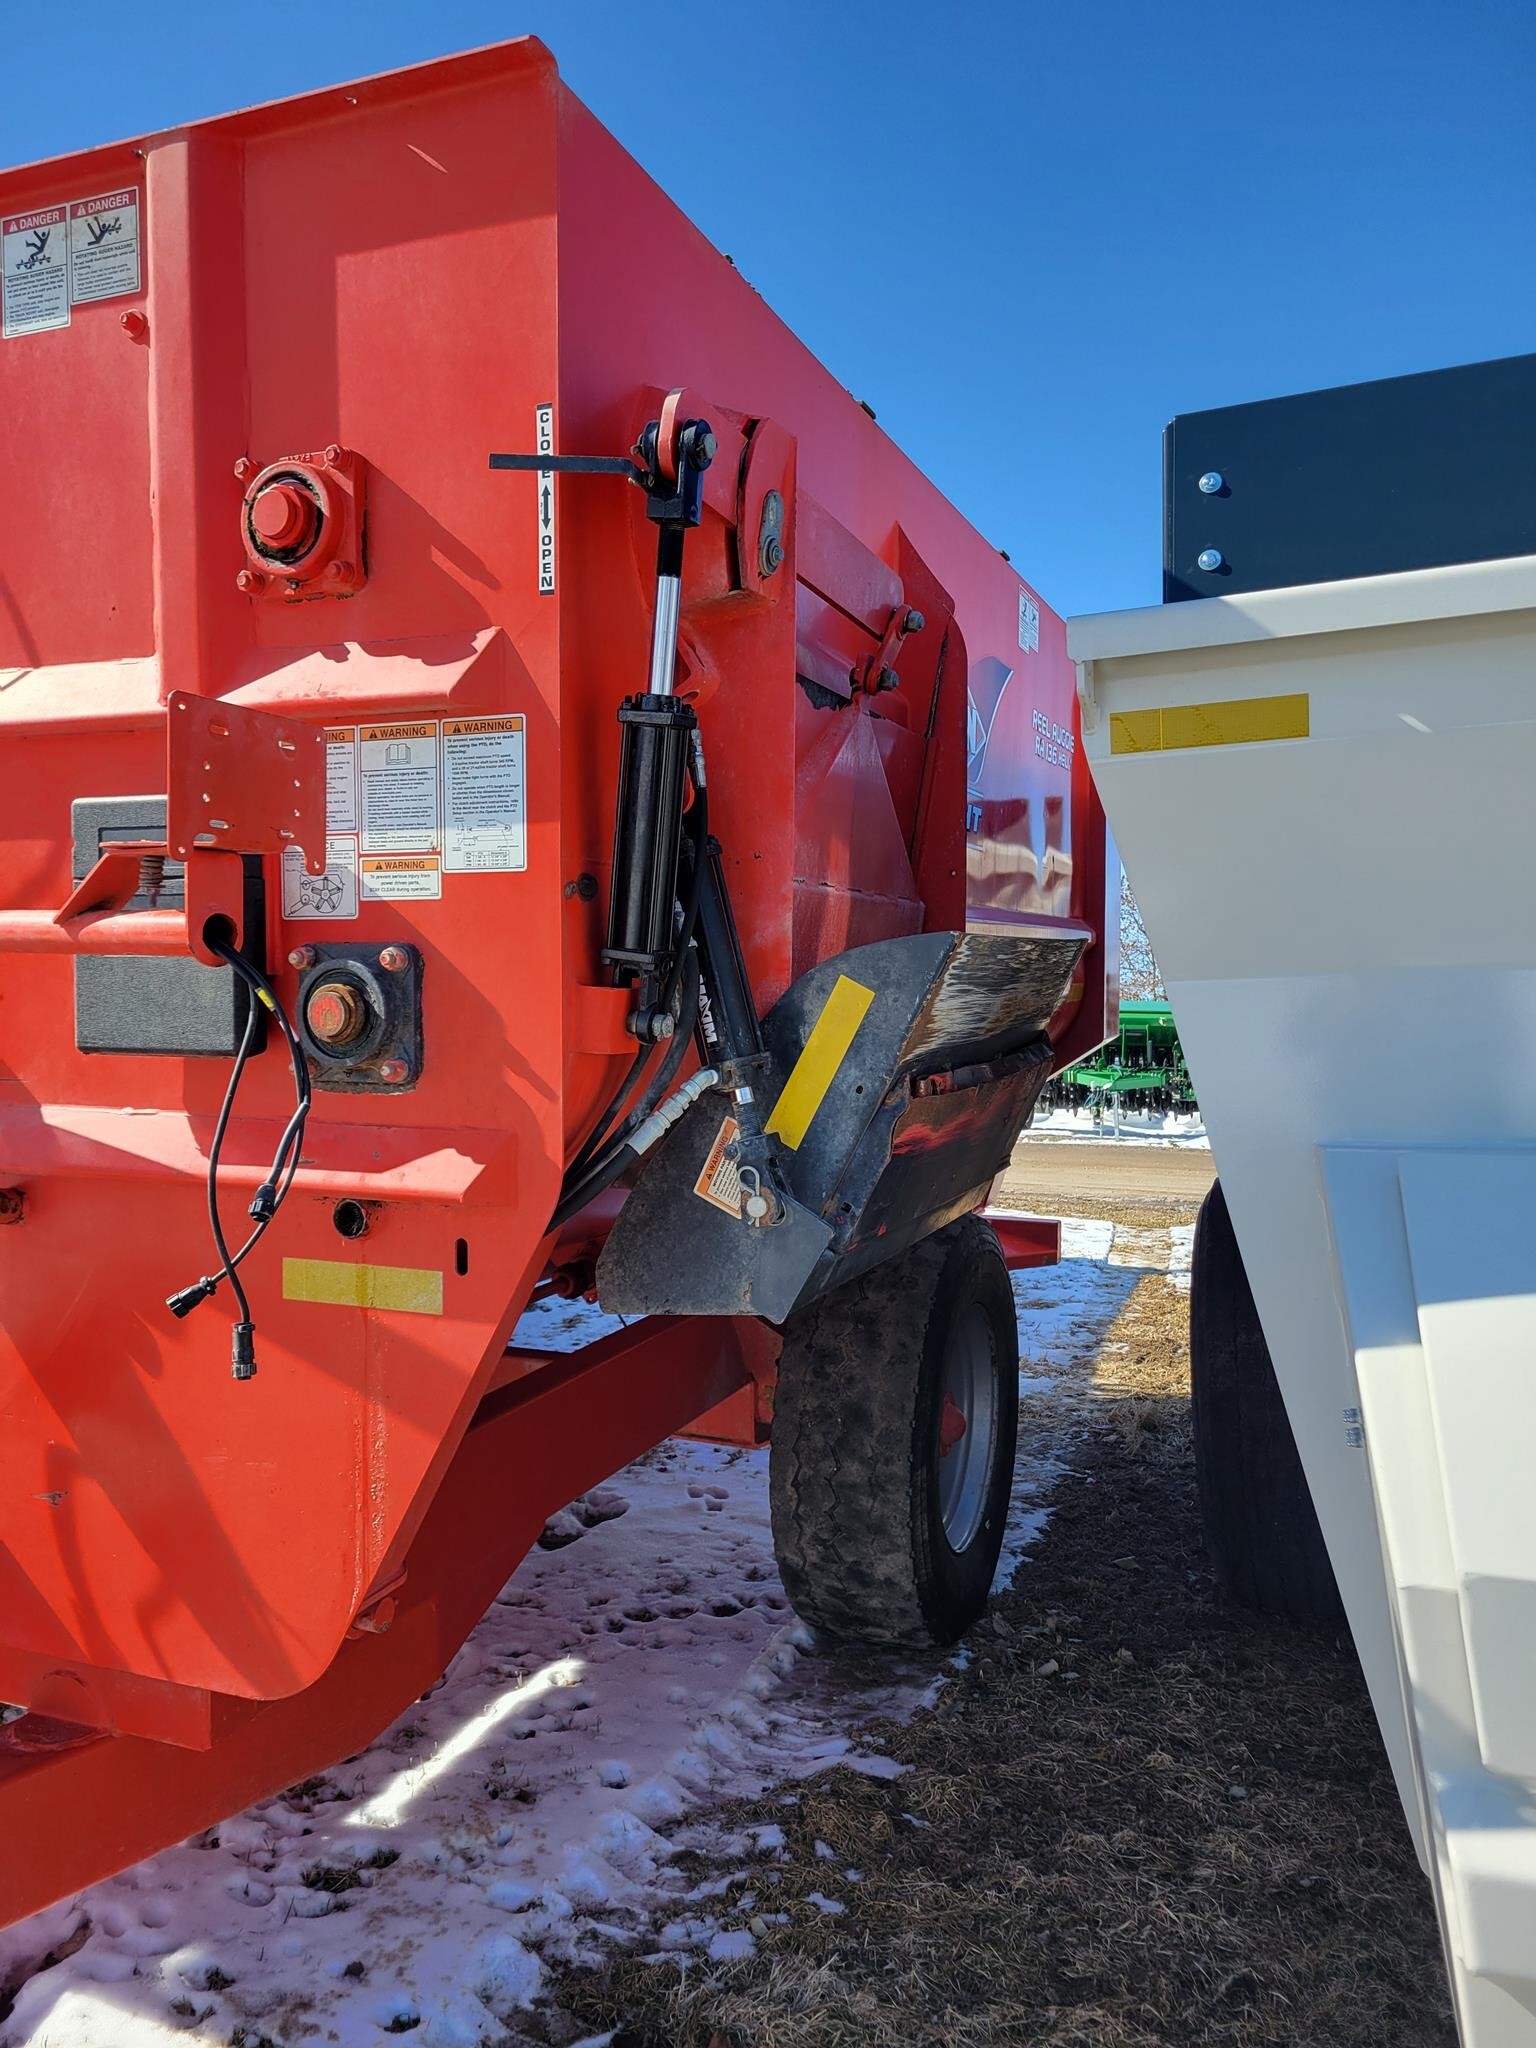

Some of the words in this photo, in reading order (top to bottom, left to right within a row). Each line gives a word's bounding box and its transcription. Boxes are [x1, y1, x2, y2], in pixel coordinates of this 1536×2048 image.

[88, 194, 129, 213] DANGER
[20, 211, 60, 230] DANGER
[540, 411, 550, 479] CLOE
[541, 534, 552, 588] OPEN
[380, 726, 426, 738] WARNING
[464, 720, 512, 732] WARNING
[1032, 708, 1050, 739] REEL
[385, 861, 424, 869] WARNING
[708, 1136, 728, 1171] WARNING
